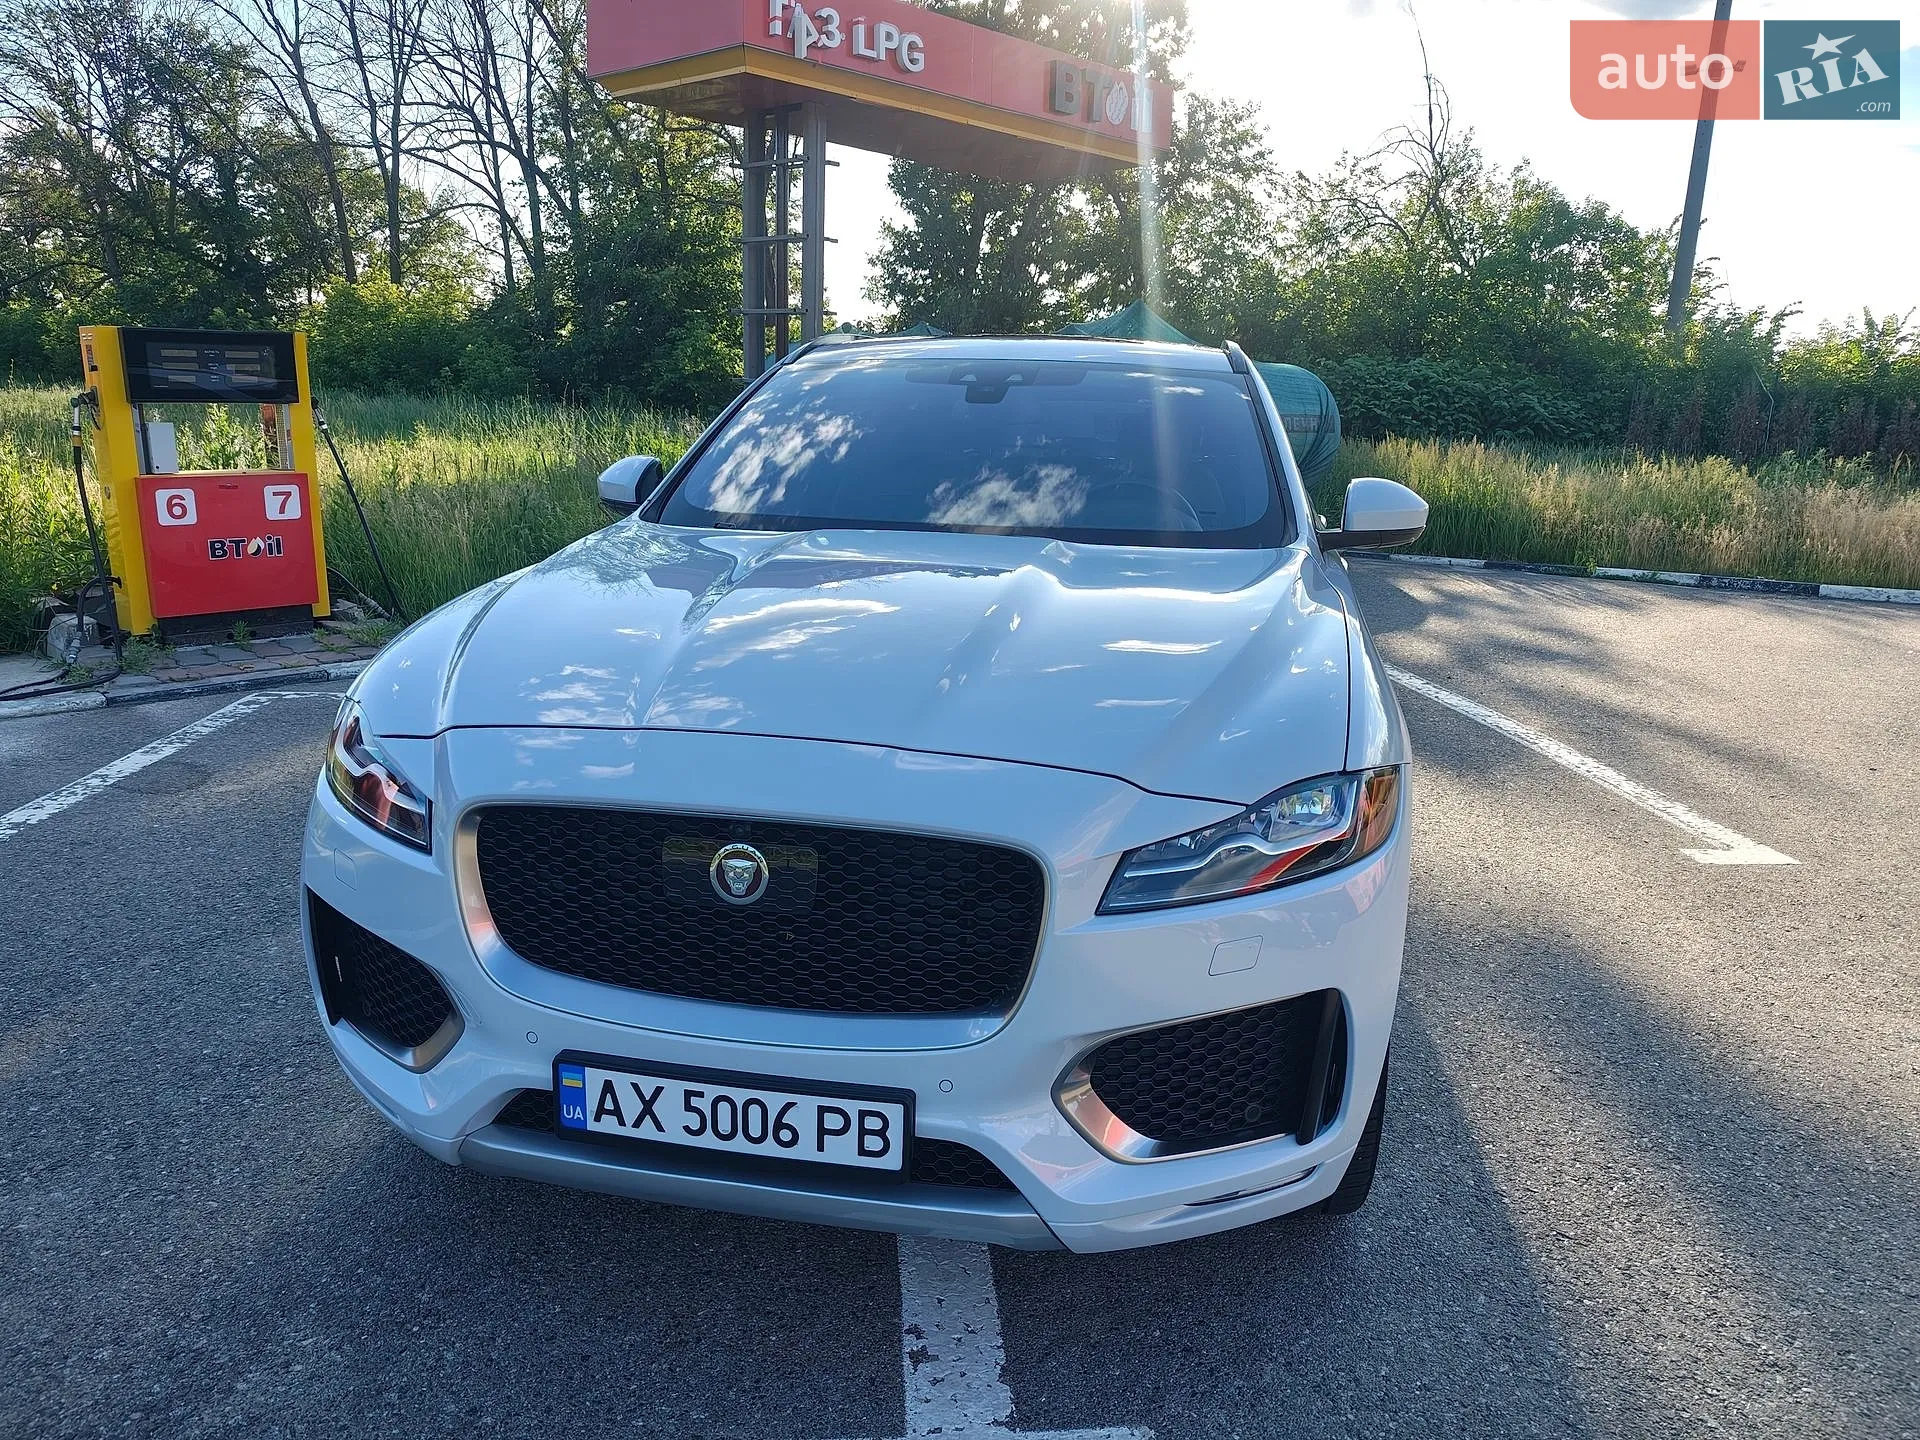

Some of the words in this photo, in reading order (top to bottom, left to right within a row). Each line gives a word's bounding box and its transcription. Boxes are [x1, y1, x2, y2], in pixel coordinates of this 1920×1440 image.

[852, 17, 926, 73] LPG
[166, 494, 188, 520] 6
[271, 490, 293, 515] 7
[563, 1103, 585, 1122] UA
[593, 1078, 666, 1133] AX
[682, 1089, 800, 1149] 5006
[816, 1104, 891, 1158] PB
